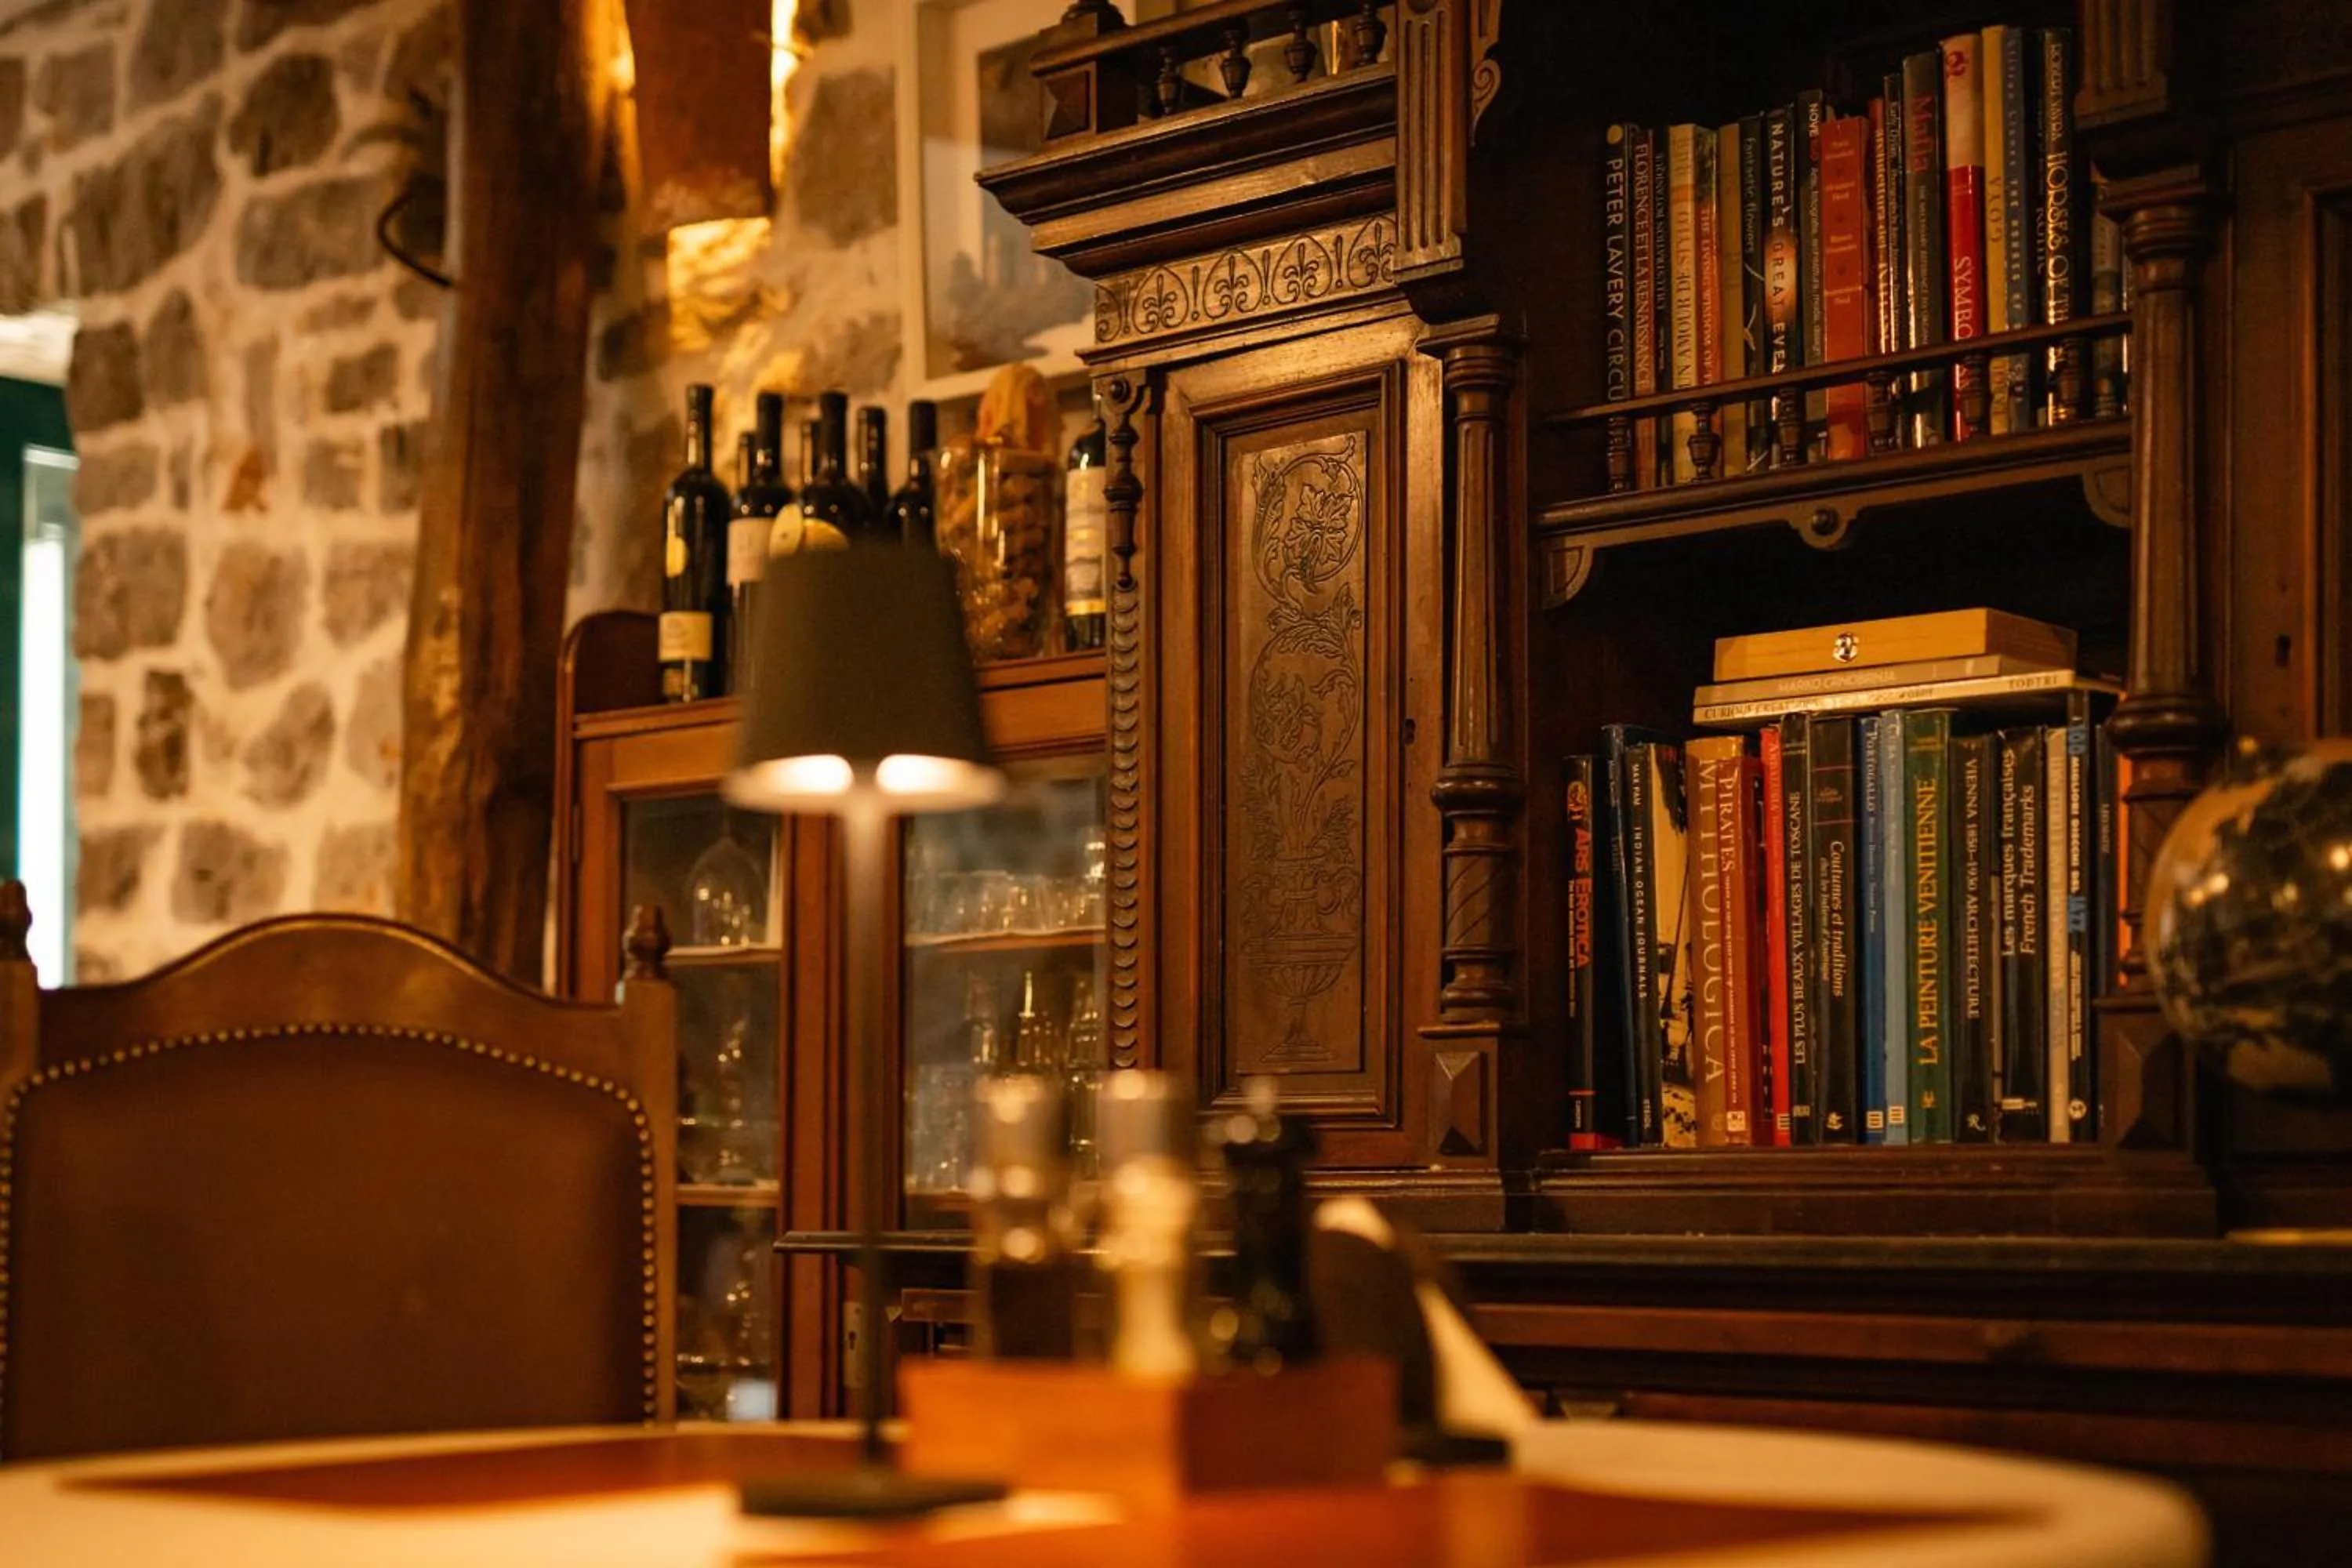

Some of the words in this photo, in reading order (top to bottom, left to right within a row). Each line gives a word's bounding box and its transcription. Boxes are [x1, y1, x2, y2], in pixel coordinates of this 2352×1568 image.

[1606, 158, 1624, 227] PETER
[1635, 143, 1649, 231] FLORENCE
[1771, 122, 1788, 228] NATURE'S
[2047, 151, 2070, 251] HORSES
[1635, 232, 1649, 252] ET
[1987, 176, 2002, 242] GOYA
[1607, 234, 1624, 319] LAVERY
[1635, 256, 1649, 278] LA
[1676, 272, 1691, 292] DE
[1772, 241, 1785, 307] GREAT
[1954, 255, 1973, 339] SYMBO
[2048, 255, 2070, 287] OF
[1635, 280, 1650, 390] RENAISSANCE
[1676, 297, 1692, 359] AMOUR
[2048, 293, 2070, 325] TH
[1607, 328, 1624, 401] CIRCU
[1772, 321, 1786, 374] EVEN
[1965, 757, 1978, 818] VIENNA
[2001, 749, 2017, 837] françaises
[1574, 828, 1591, 873] ARS
[1634, 826, 1643, 873] INDIAN
[1719, 774, 1736, 872] PIRATES
[1788, 791, 1802, 857] TOSCANE
[1915, 778, 1937, 913] VENITIENNE
[2019, 785, 2034, 887] Trademarks
[1635, 881, 1645, 924] OCEAN
[1789, 861, 1802, 880] DE
[1831, 840, 1846, 910] Coutumes
[2002, 844, 2017, 920] marques
[1575, 877, 1592, 968] EROTICA
[1699, 758, 1724, 1083] MYTHOLOGICA
[1790, 883, 1803, 948] VILLAGES
[1831, 913, 1845, 926] et
[2002, 926, 2015, 956] Les
[2020, 894, 2035, 954] French
[2069, 895, 2086, 933] JAZZ
[1636, 932, 1647, 999] JOURNALS
[1791, 952, 1805, 1000] BEAUX
[1831, 930, 1846, 997] traditions
[1917, 920, 1937, 1029] PEINTURE
[1966, 894, 1980, 1019] ARCHITECTURE
[1792, 1004, 1806, 1037] PLUS
[1793, 1040, 1806, 1064] LES
[1918, 1035, 1938, 1065] LA
